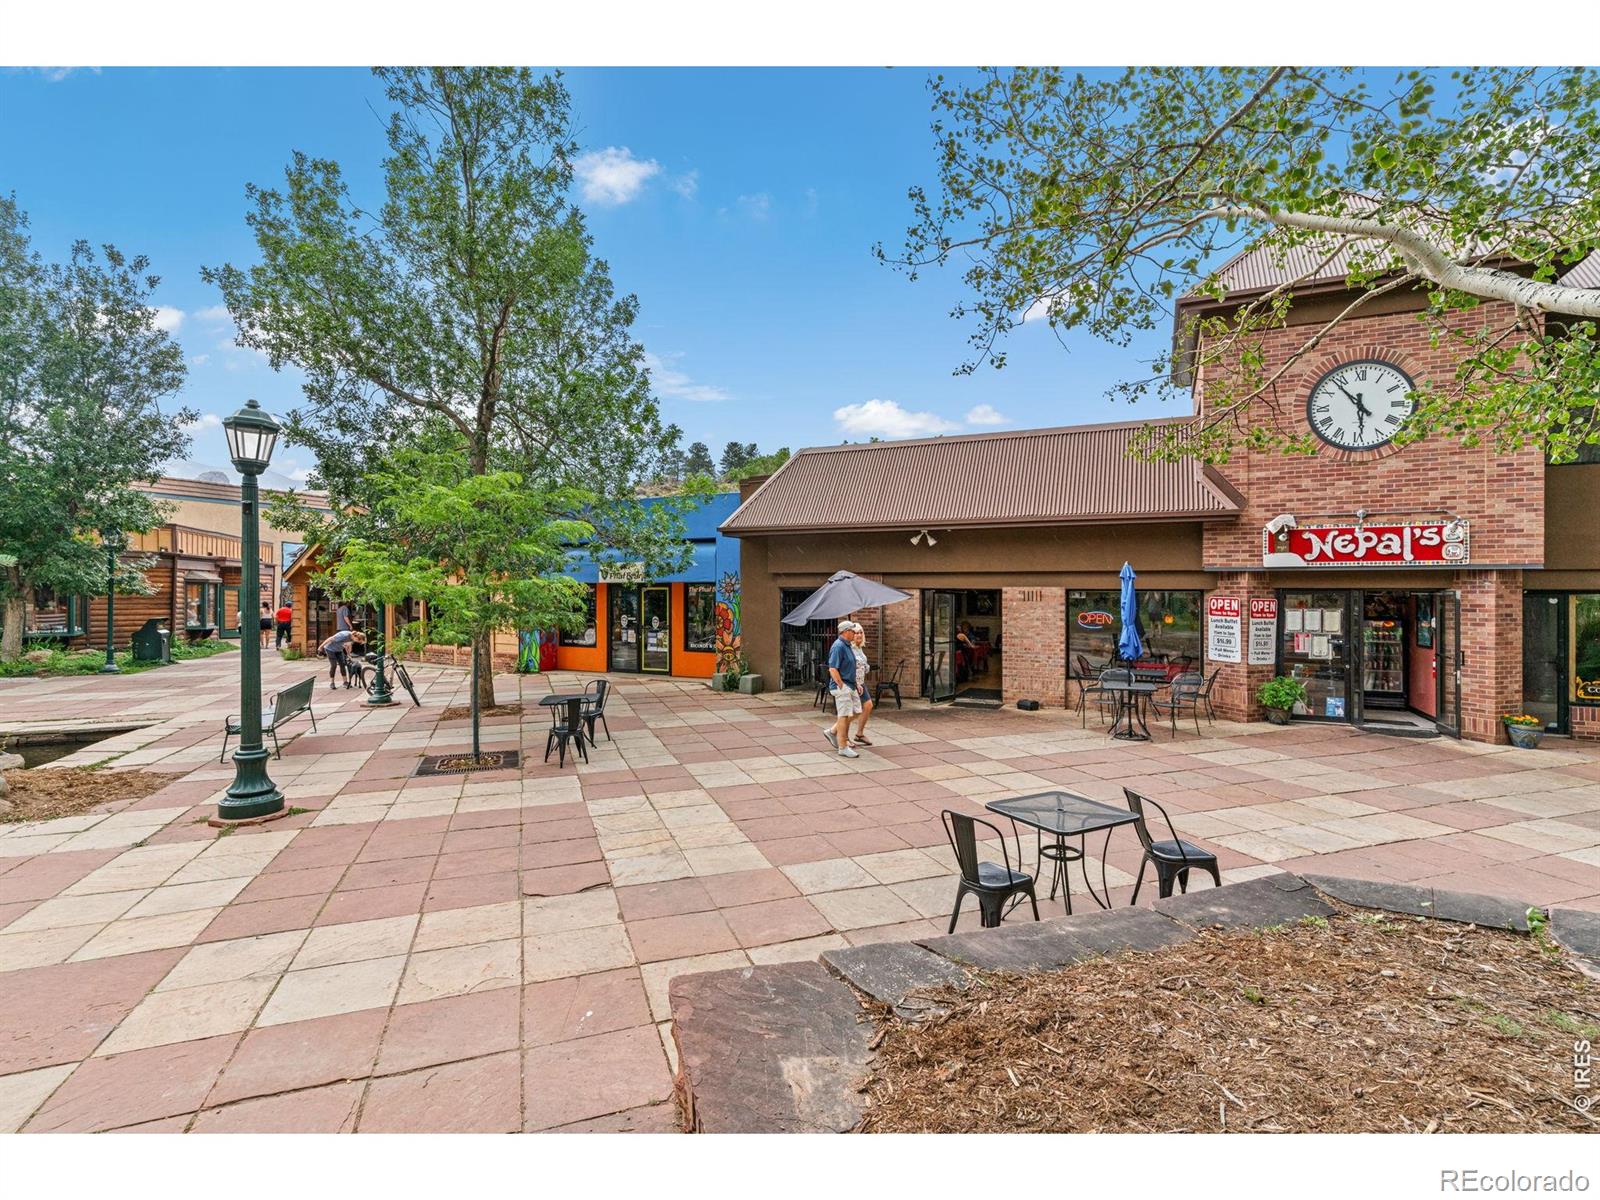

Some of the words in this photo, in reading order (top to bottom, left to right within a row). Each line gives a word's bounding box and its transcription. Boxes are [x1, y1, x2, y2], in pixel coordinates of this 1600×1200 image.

[1302, 526, 1440, 562] Nepal's
[1210, 599, 1238, 611] OPEN
[1252, 601, 1276, 612] OPEN
[1078, 612, 1112, 625] OPEN
